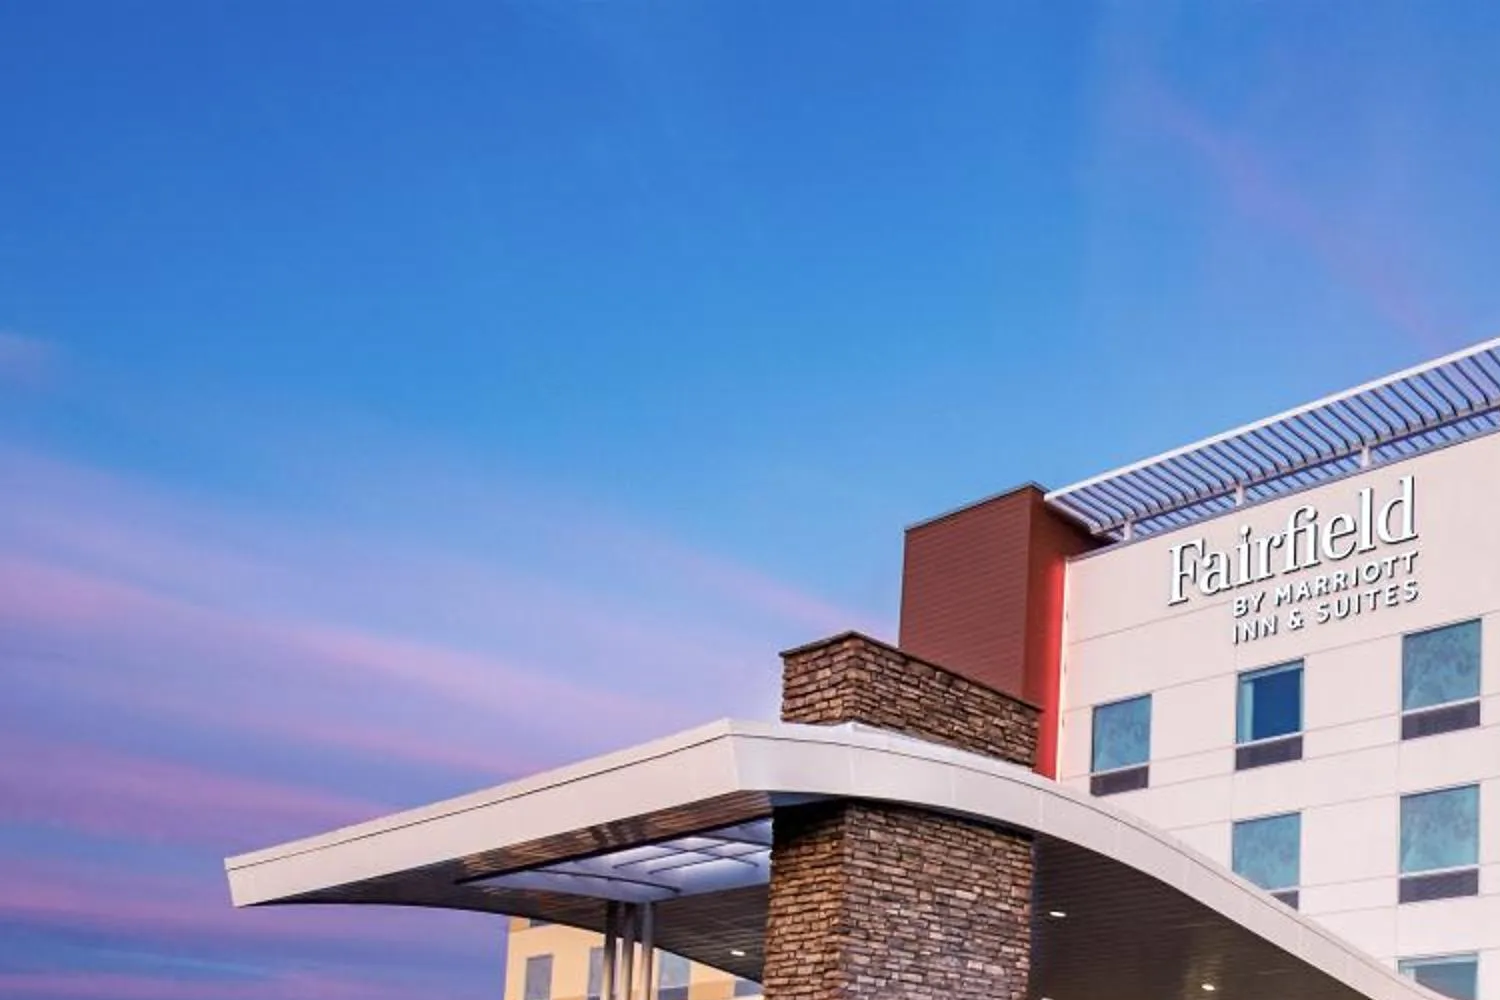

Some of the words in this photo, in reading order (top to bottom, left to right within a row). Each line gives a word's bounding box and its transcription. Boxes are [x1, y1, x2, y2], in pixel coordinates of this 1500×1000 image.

[1167, 475, 1418, 606] Fairfield
[1232, 591, 1265, 618] BY
[1276, 551, 1418, 607] MARRIOTT
[1232, 616, 1278, 644] INN
[1287, 610, 1304, 631] &
[1316, 580, 1419, 625] SUITES
